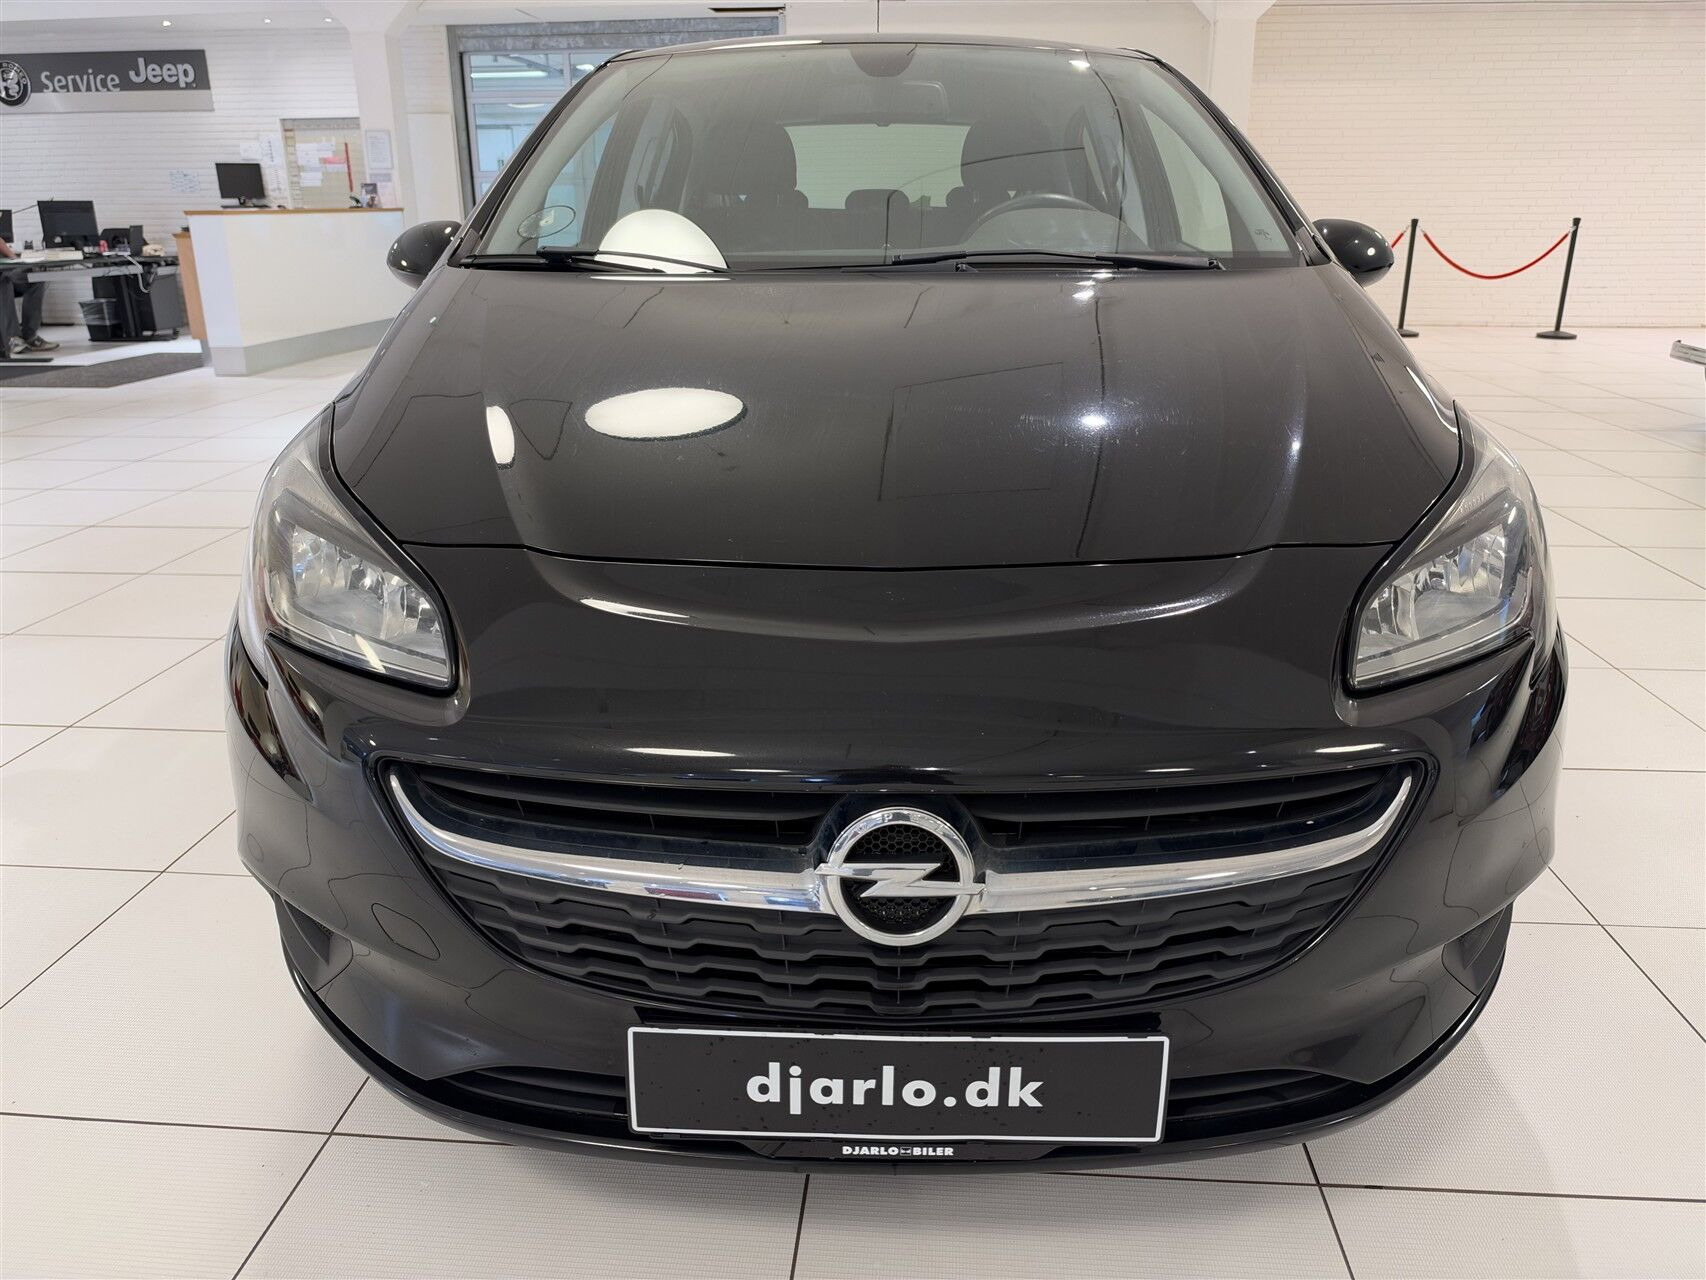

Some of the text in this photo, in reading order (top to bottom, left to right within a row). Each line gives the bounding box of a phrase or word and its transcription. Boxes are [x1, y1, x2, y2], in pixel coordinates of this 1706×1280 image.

[40, 68, 121, 94] Service
[128, 57, 195, 88] Jeep
[746, 1061, 1044, 1115] djarlo.dk
[842, 1145, 954, 1156] DJARLO BILER
